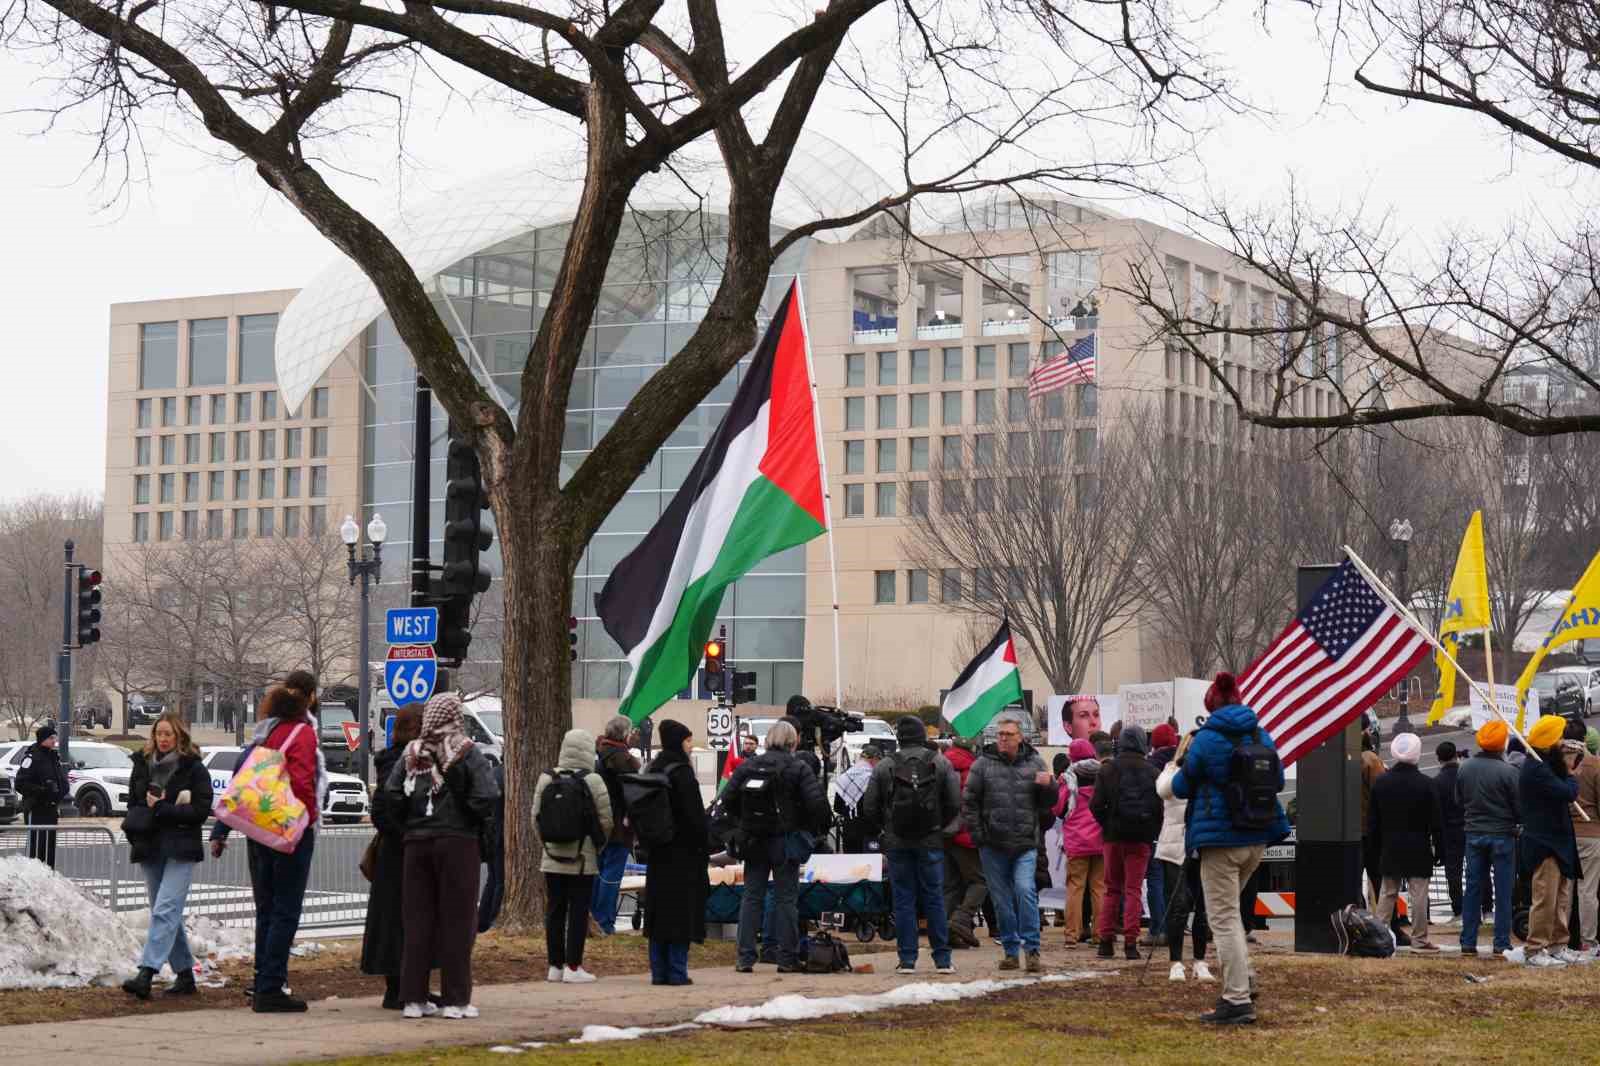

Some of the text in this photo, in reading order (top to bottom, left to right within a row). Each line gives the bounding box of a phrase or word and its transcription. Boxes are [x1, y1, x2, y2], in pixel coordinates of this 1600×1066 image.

[393, 615, 430, 636] WEST
[393, 648, 428, 658] INTERSTATE
[392, 664, 428, 699] 66
[710, 714, 730, 729] 50
